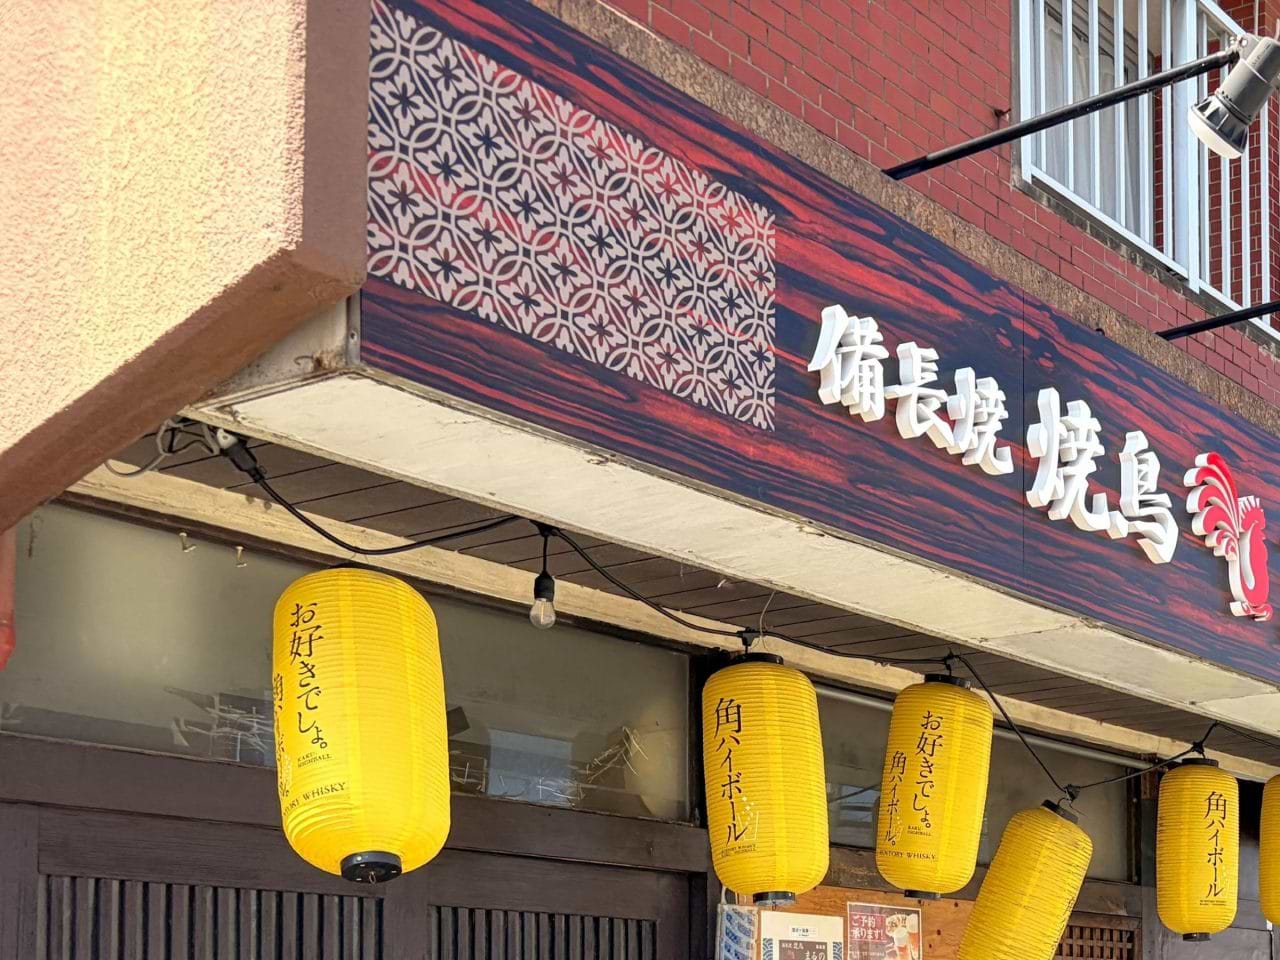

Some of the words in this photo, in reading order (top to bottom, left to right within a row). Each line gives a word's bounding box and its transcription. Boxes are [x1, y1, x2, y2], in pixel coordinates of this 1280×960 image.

[1026, 388, 1179, 564] 焼鳥
[302, 782, 345, 800] WHISKY
[714, 697, 748, 846] 角ハイボール
[1204, 791, 1228, 898] 角ハイボール
[851, 914, 876, 928] ご予約
